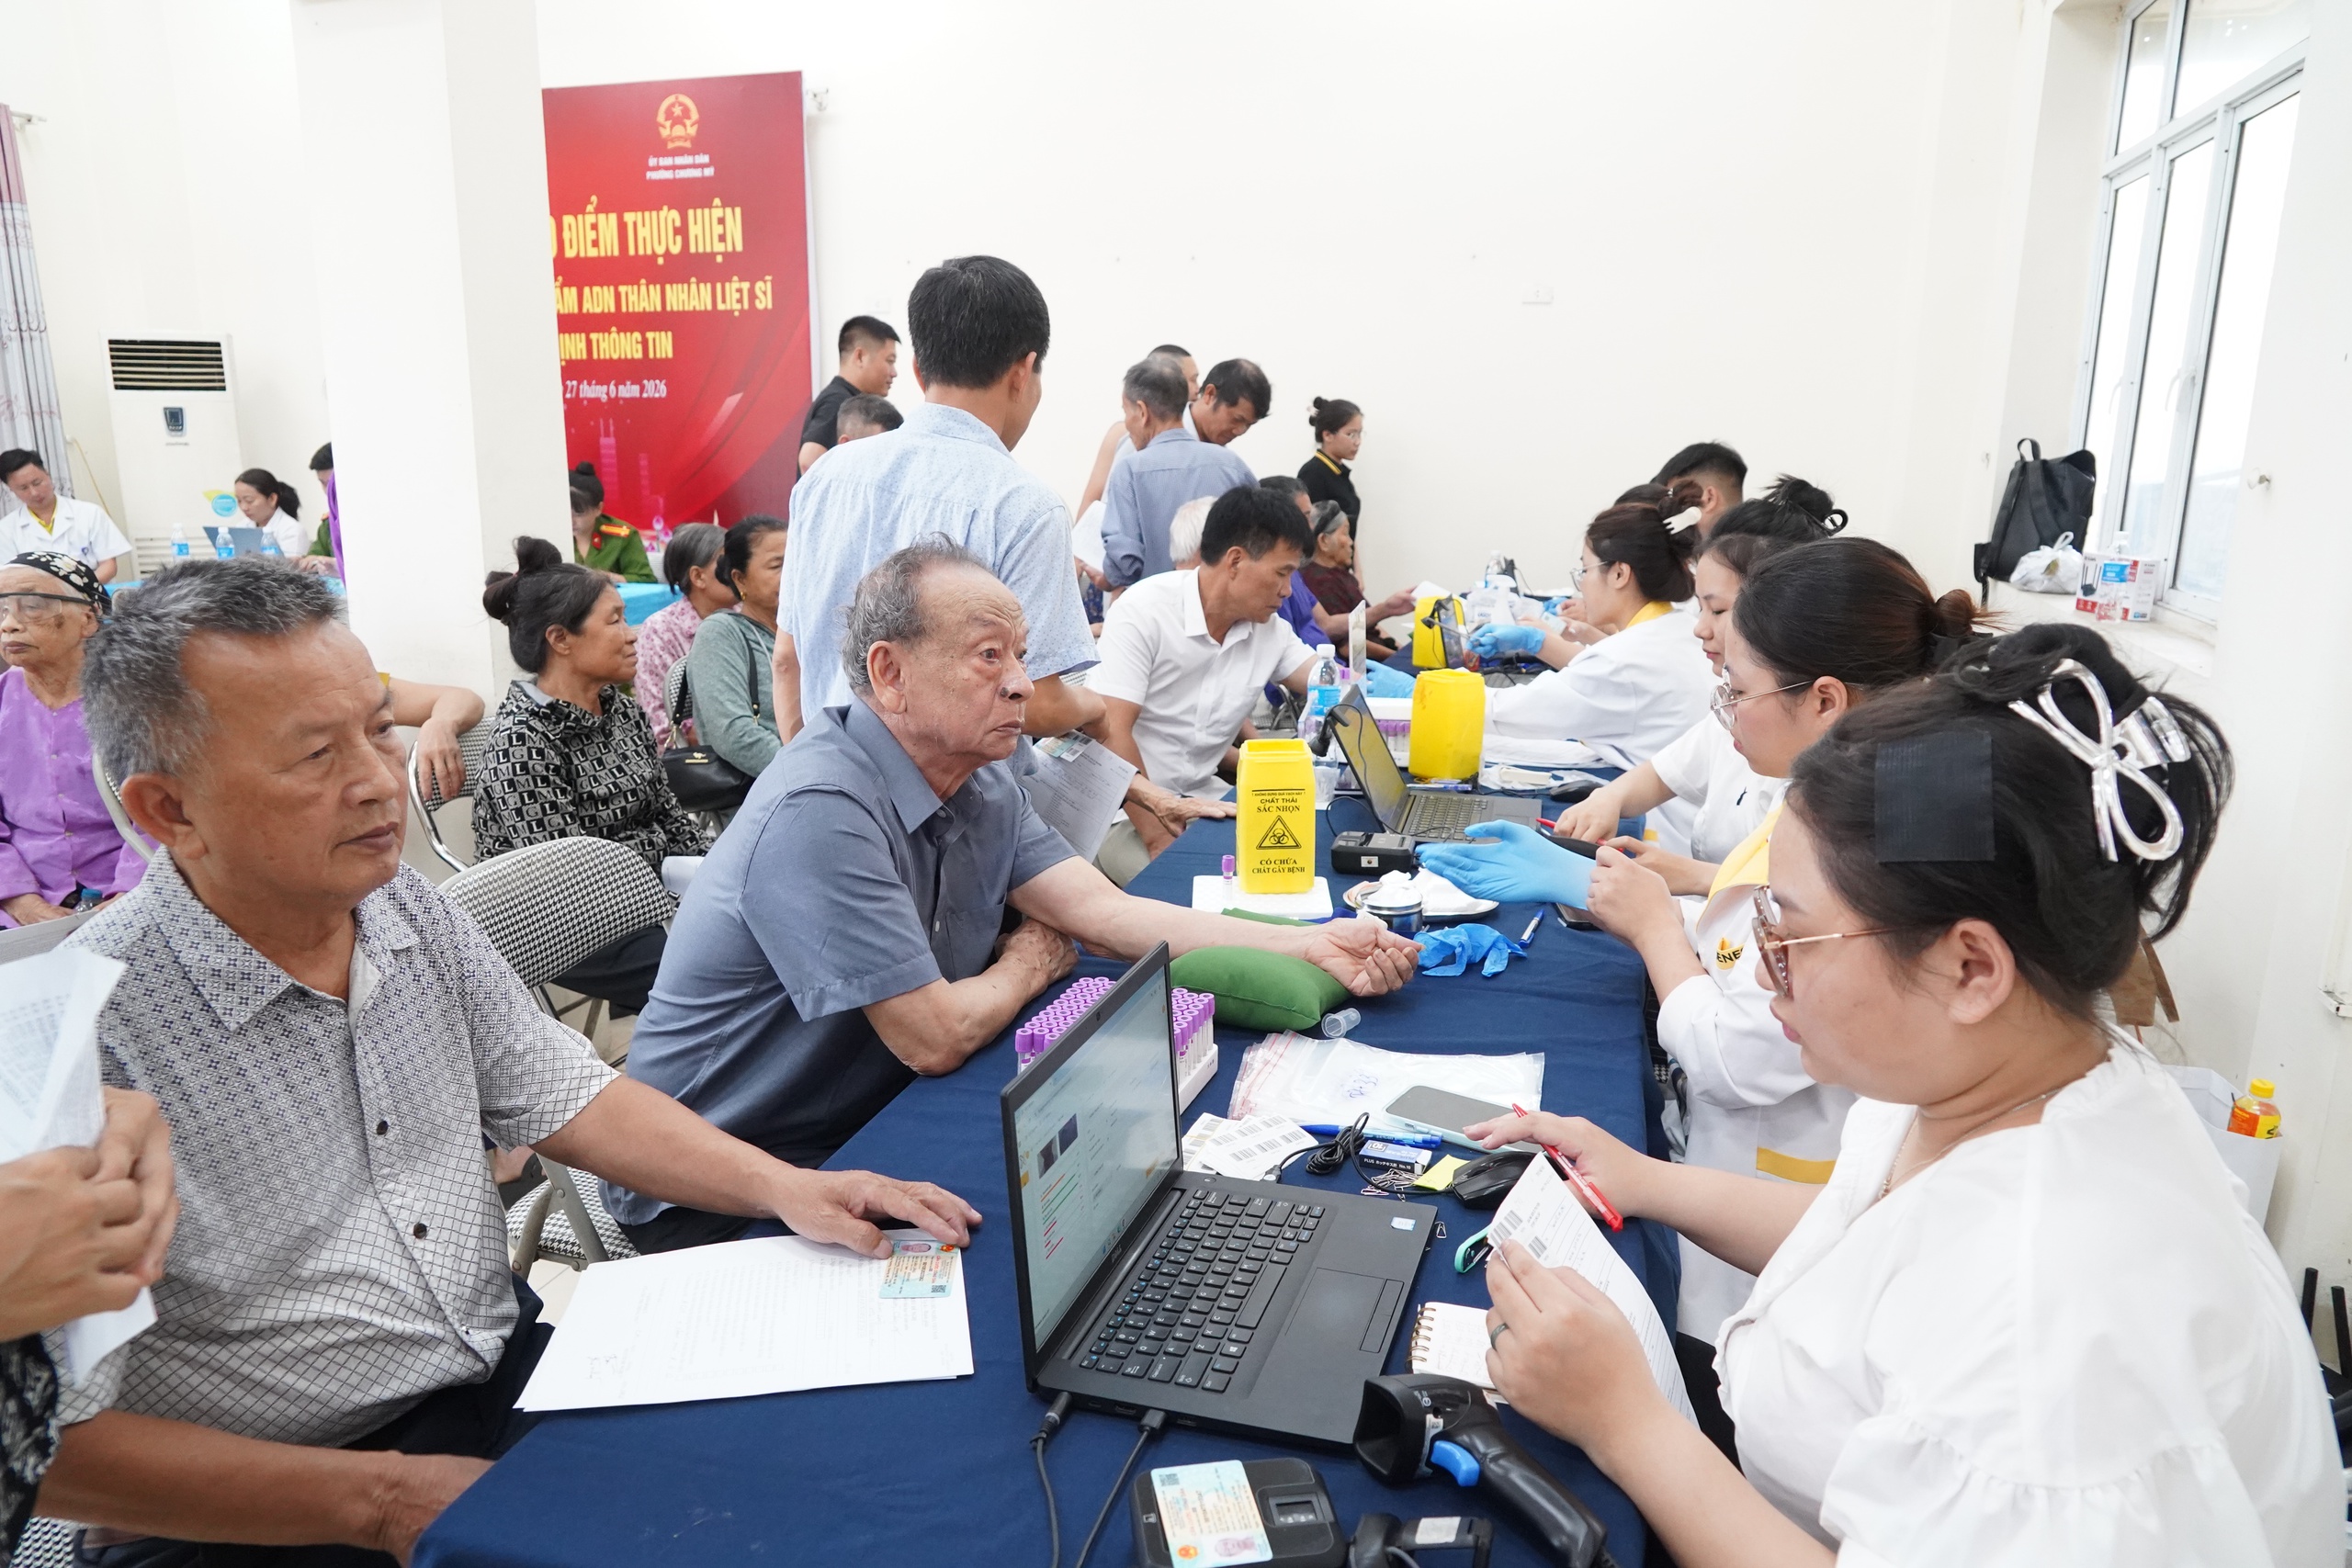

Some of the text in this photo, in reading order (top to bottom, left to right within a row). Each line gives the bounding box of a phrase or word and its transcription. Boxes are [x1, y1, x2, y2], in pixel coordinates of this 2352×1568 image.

[562, 195, 619, 258] ĐIỂM
[623, 205, 683, 265] THỰC
[687, 197, 743, 263] HIỆN
[582, 286, 616, 314] ADN
[618, 277, 662, 313] THÂN
[665, 276, 712, 311] NHÂN
[716, 276, 751, 317] LIỆT
[754, 275, 773, 310] SĨ
[589, 326, 643, 360] THÔNG
[646, 331, 673, 359] TIN
[565, 379, 667, 402] 27 tháng 6 năm 2026
[1275, 805, 1301, 814] NHỌN
[1273, 857, 1297, 865] CHỨA
